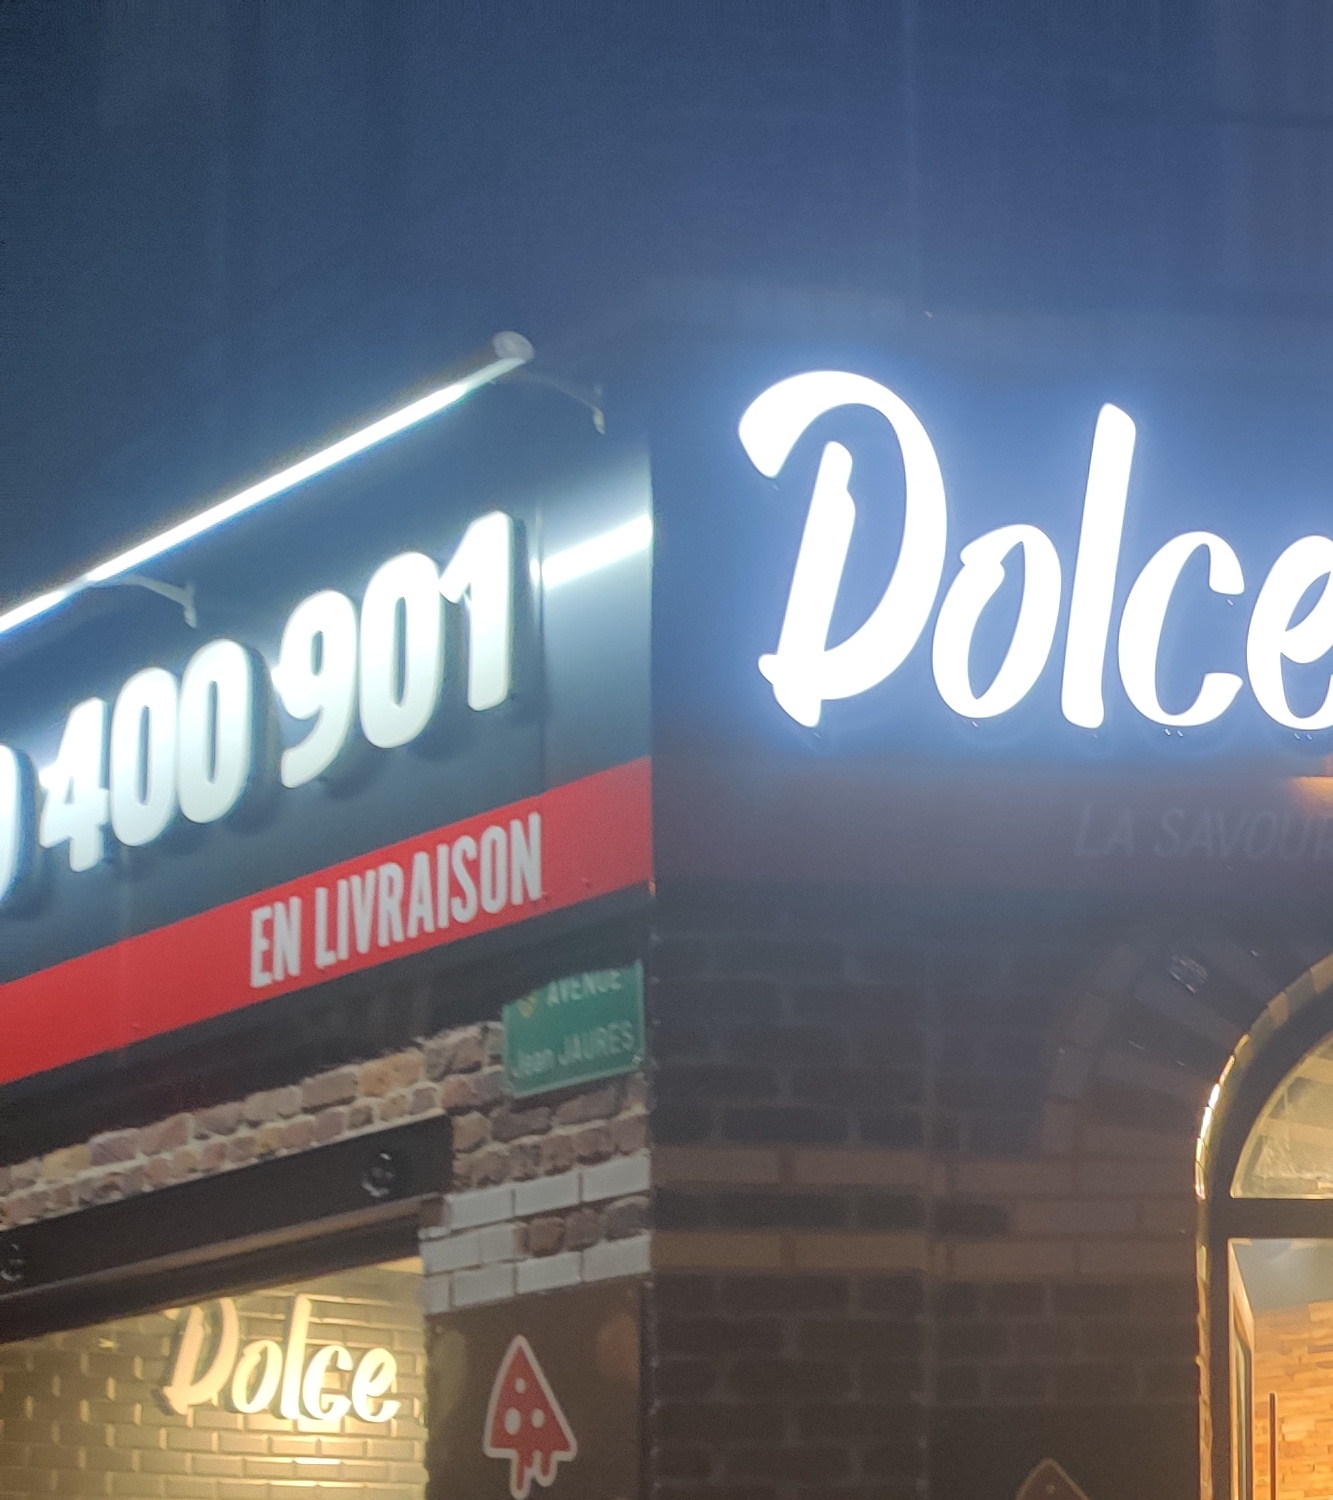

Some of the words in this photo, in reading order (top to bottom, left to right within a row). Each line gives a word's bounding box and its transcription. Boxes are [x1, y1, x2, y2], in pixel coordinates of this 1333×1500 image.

[38, 639, 254, 872] 400
[272, 511, 514, 790] 901
[1074, 803, 1134, 857] LA
[250, 896, 302, 988] EN
[315, 811, 542, 970] LIVRAISON
[547, 969, 623, 1006] AVENUE
[162, 1293, 400, 1423] Dolce
